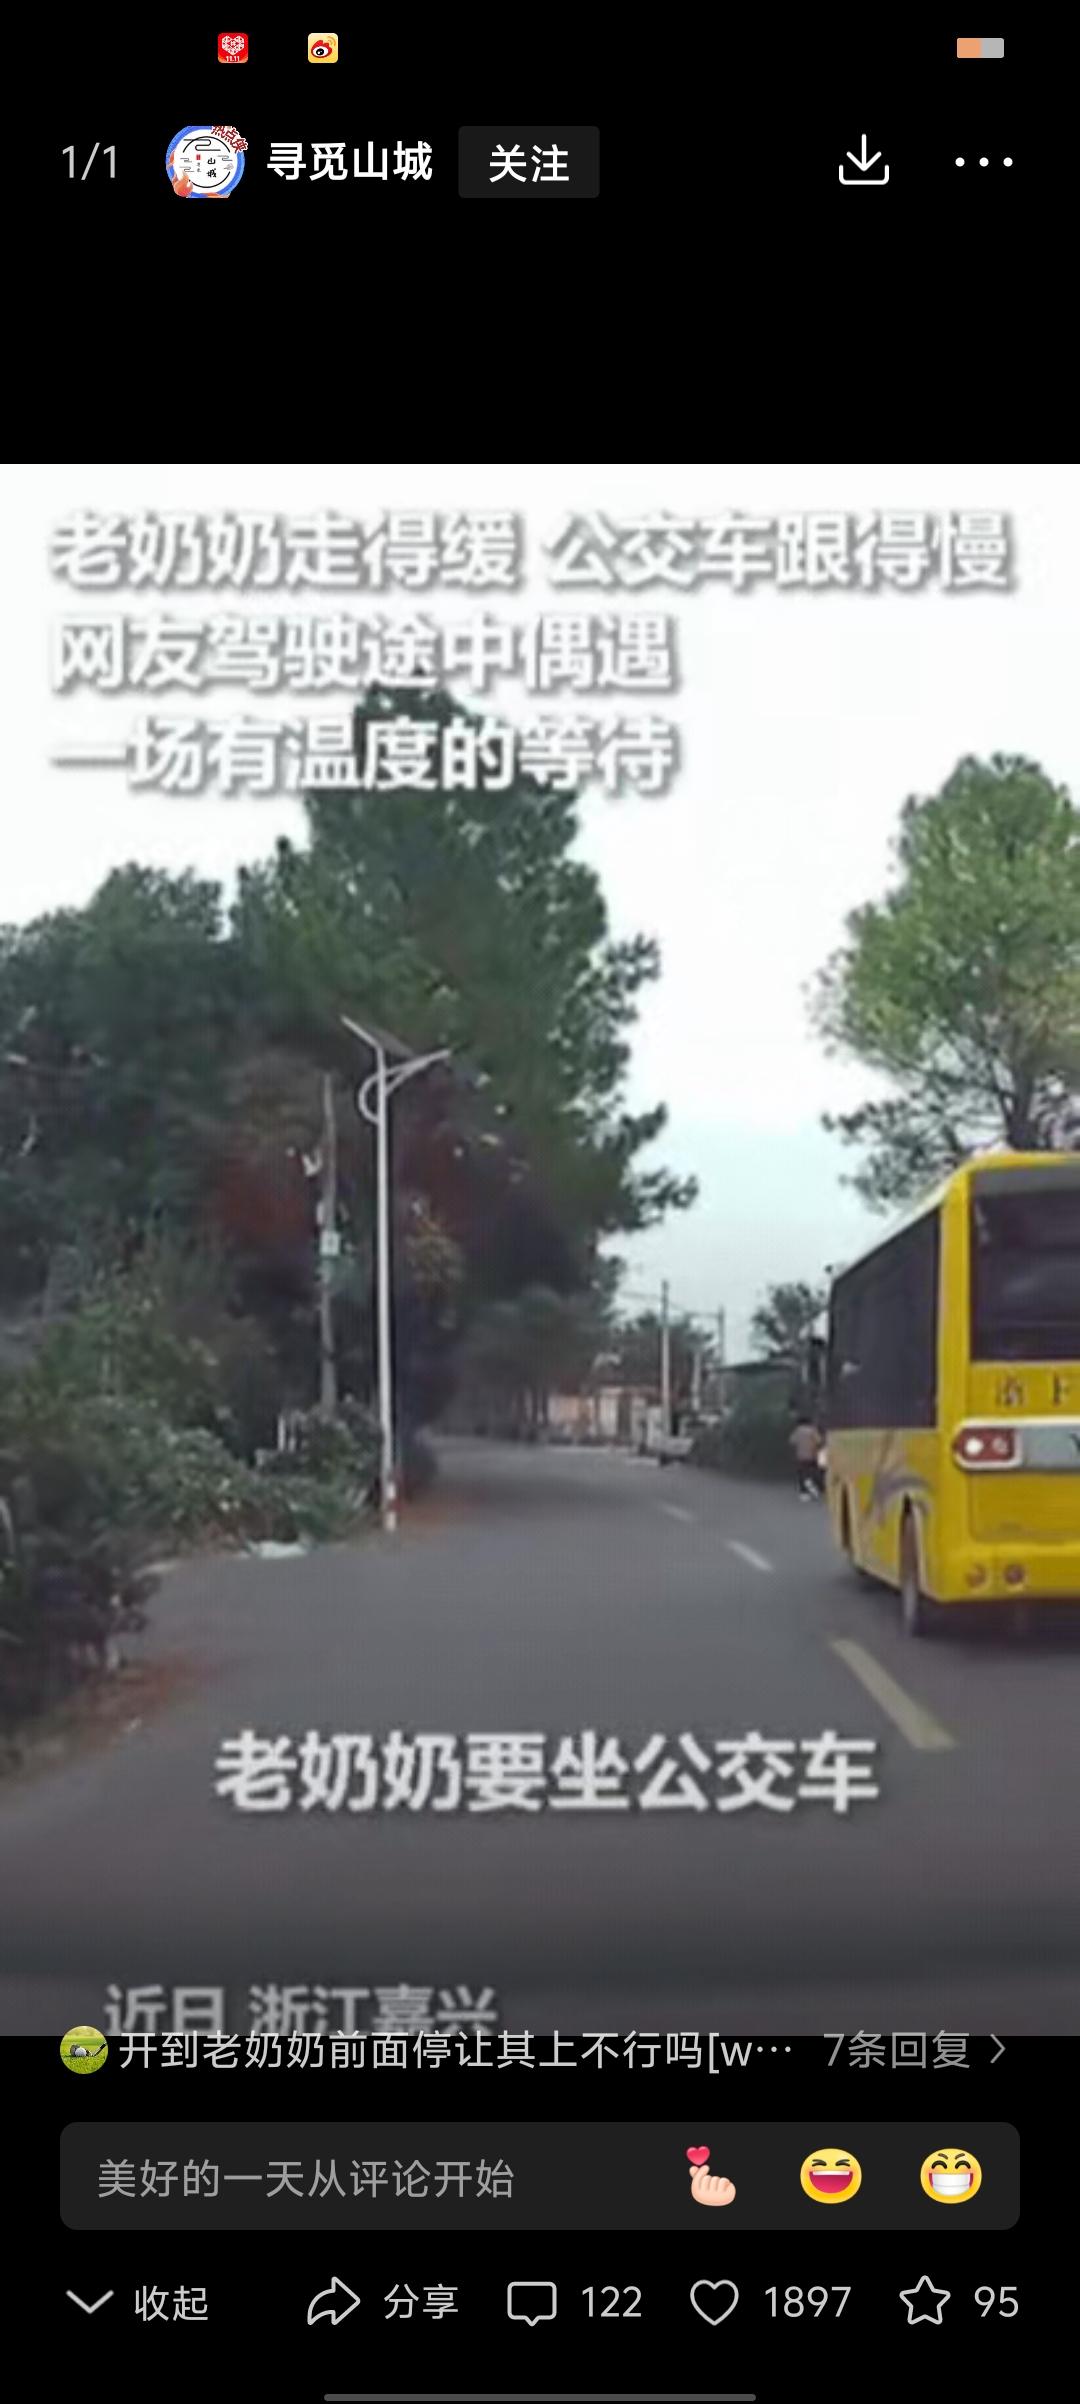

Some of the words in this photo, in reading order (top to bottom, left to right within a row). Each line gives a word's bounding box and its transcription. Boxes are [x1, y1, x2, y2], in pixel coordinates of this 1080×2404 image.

[62, 142, 117, 181] 1/1
[267, 141, 433, 182] 寻觅山城
[489, 143, 570, 183] 关注
[823, 2030, 970, 2069] 7条回复
[97, 2158, 515, 2199] 美好的一天从评论开始
[134, 2285, 209, 2322] 收起
[383, 2283, 459, 2320] 分享
[582, 2285, 642, 2318] 122
[765, 2285, 852, 2318] 1897
[974, 2285, 1019, 2318] 95
